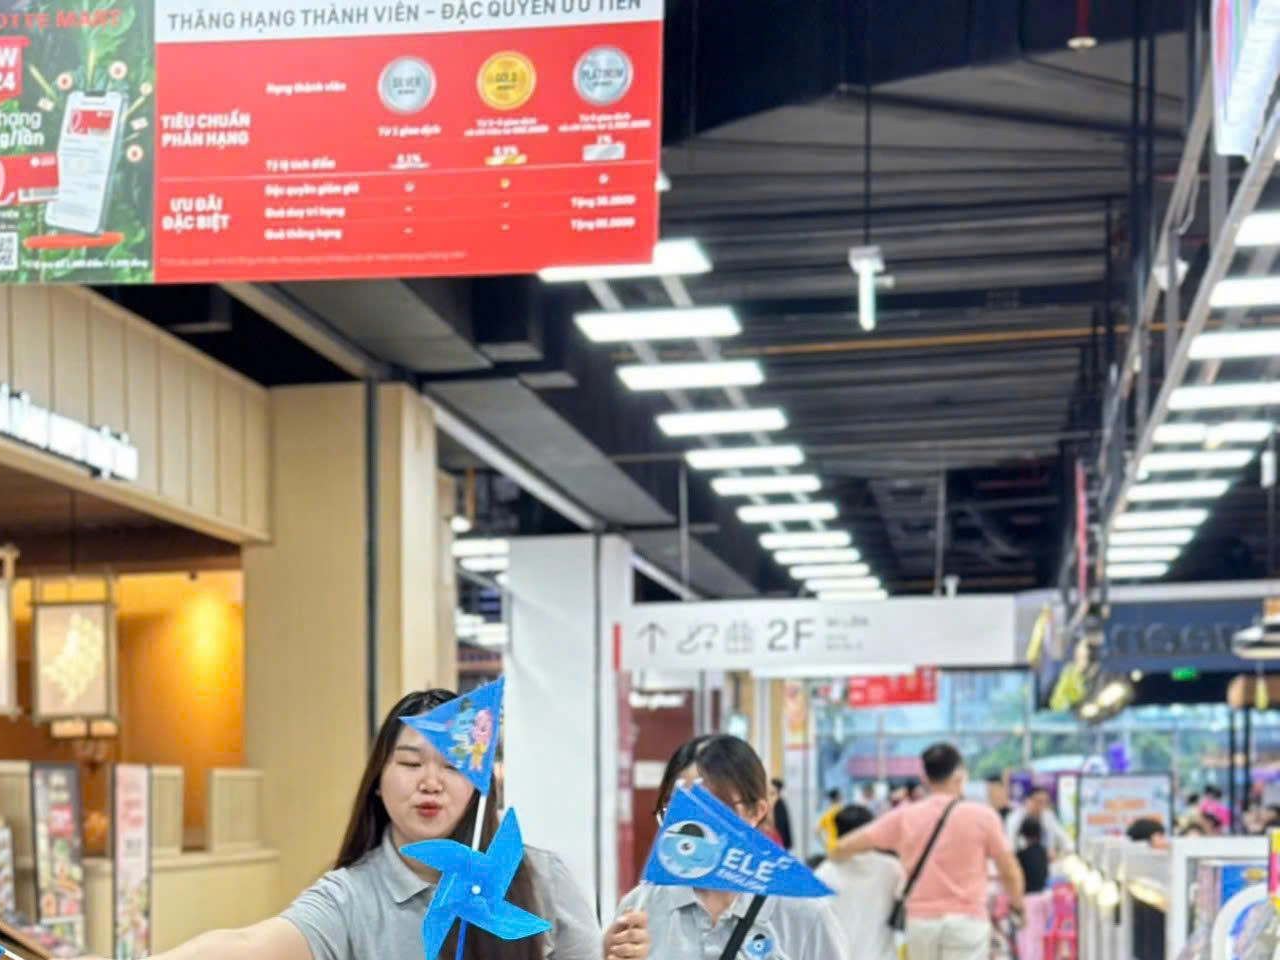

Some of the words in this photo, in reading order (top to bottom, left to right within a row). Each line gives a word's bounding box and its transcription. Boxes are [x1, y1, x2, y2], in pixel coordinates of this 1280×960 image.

[56, 9, 121, 28] MART
[168, 9, 235, 31] THĂNG
[240, 10, 296, 33] HẠNG
[302, 2, 369, 26] THÀNH
[373, 1, 419, 22] VIÊN
[160, 112, 195, 128] TIÊU
[161, 130, 204, 147] PHÂN
[206, 130, 250, 150] HẠNG
[767, 618, 816, 652] 2F
[723, 847, 776, 884] ELE
